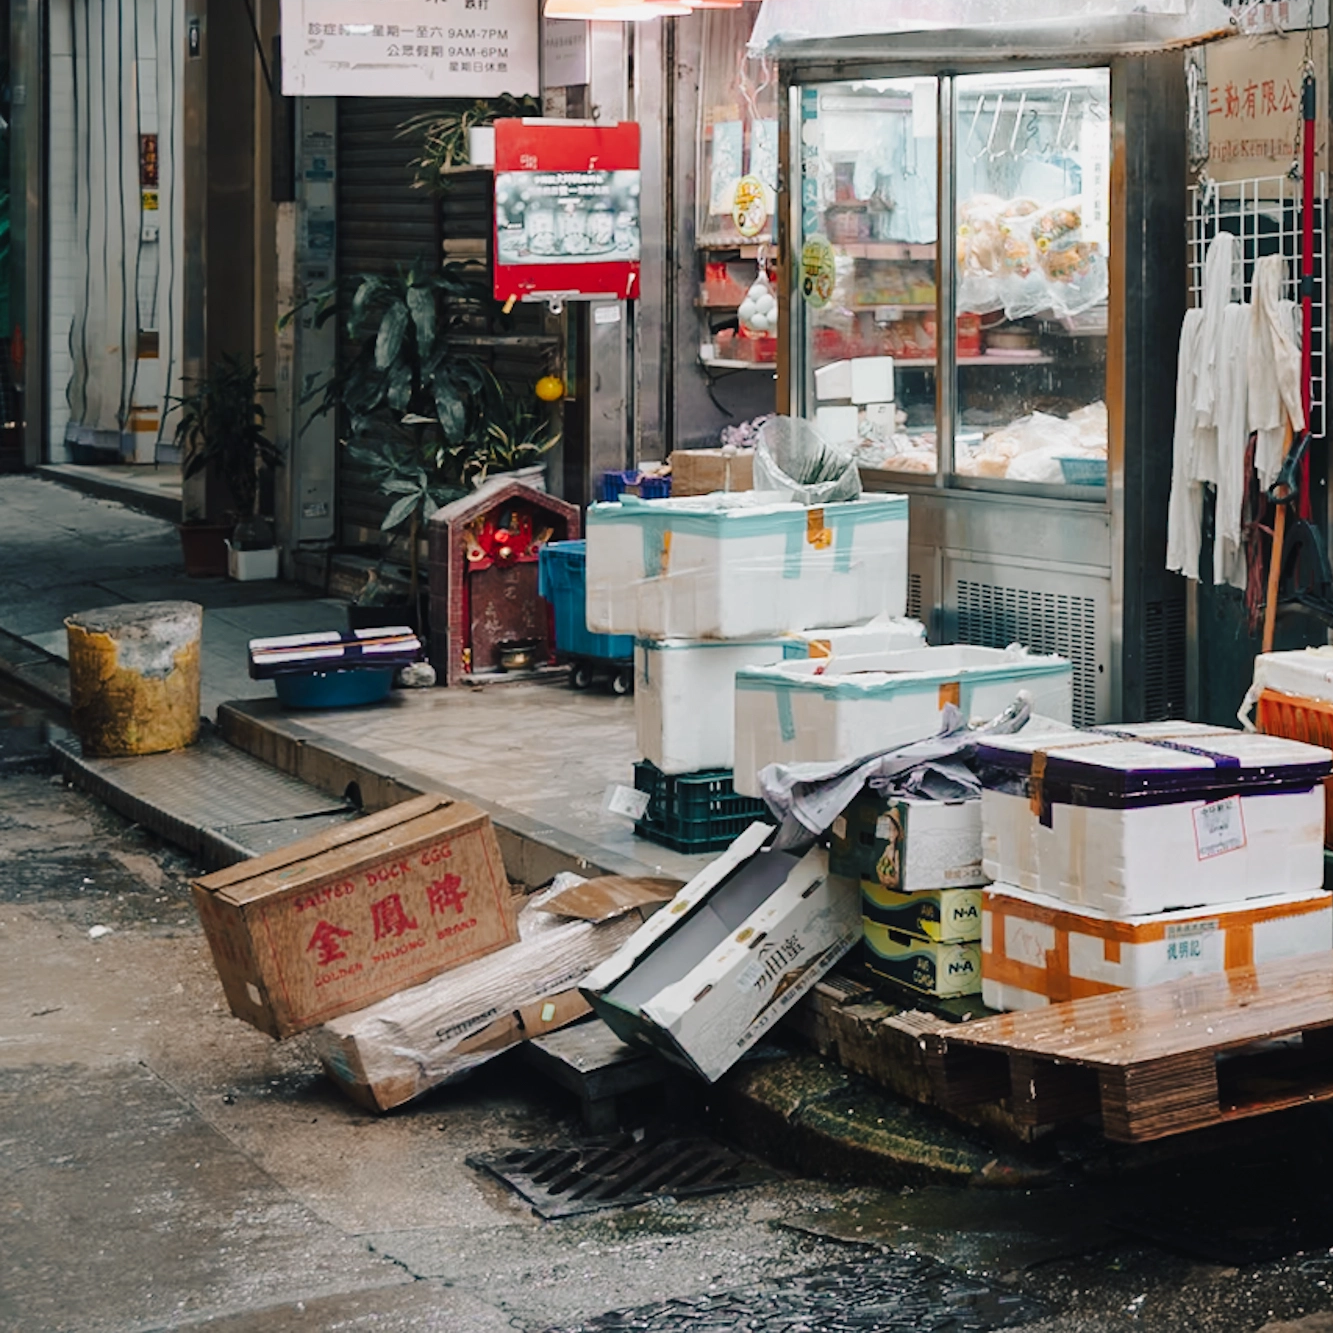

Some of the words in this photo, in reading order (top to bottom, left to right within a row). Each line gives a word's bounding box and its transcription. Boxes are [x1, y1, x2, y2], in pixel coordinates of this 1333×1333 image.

[448, 28, 508, 40] 9AM-7PM
[448, 47, 508, 58] 9AM-6PM
[294, 881, 356, 913] SALTED
[306, 872, 469, 967] 金鳳牌
